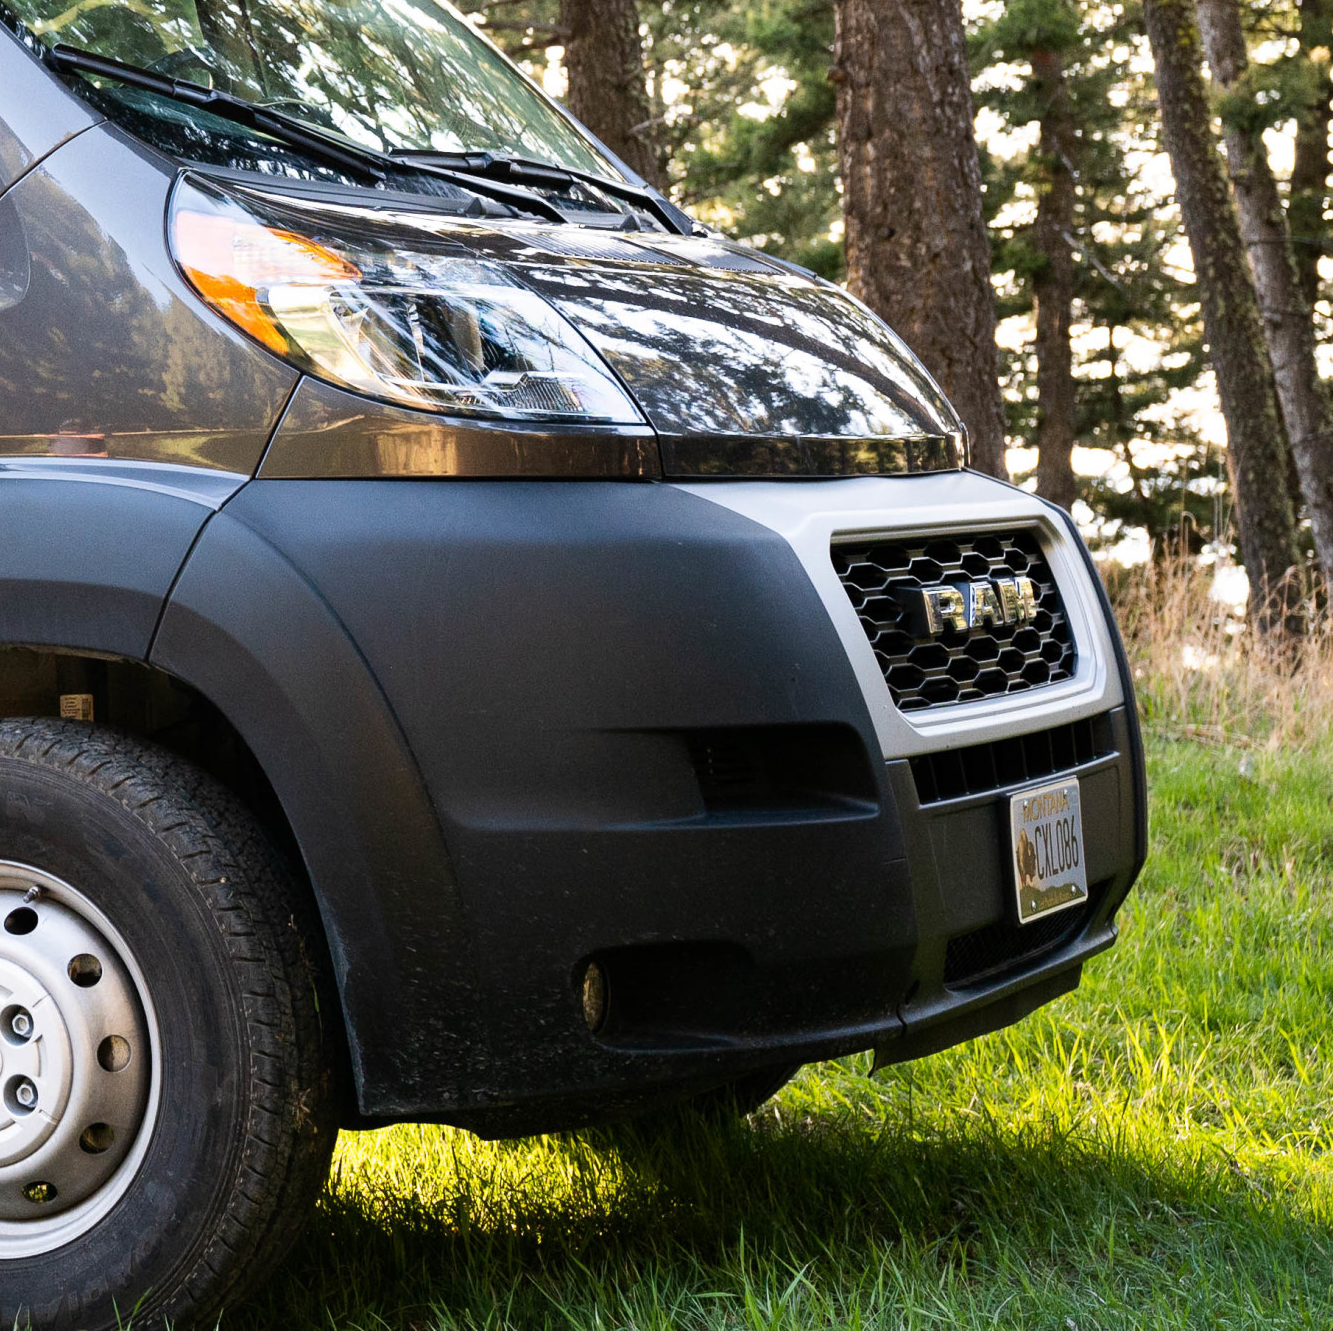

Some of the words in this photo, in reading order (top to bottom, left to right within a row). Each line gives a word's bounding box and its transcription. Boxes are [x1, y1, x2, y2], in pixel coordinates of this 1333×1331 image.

[921, 576, 1037, 634] RAM
[1022, 789, 1070, 823] MONTANA
[1034, 814, 1079, 880] CXL086
